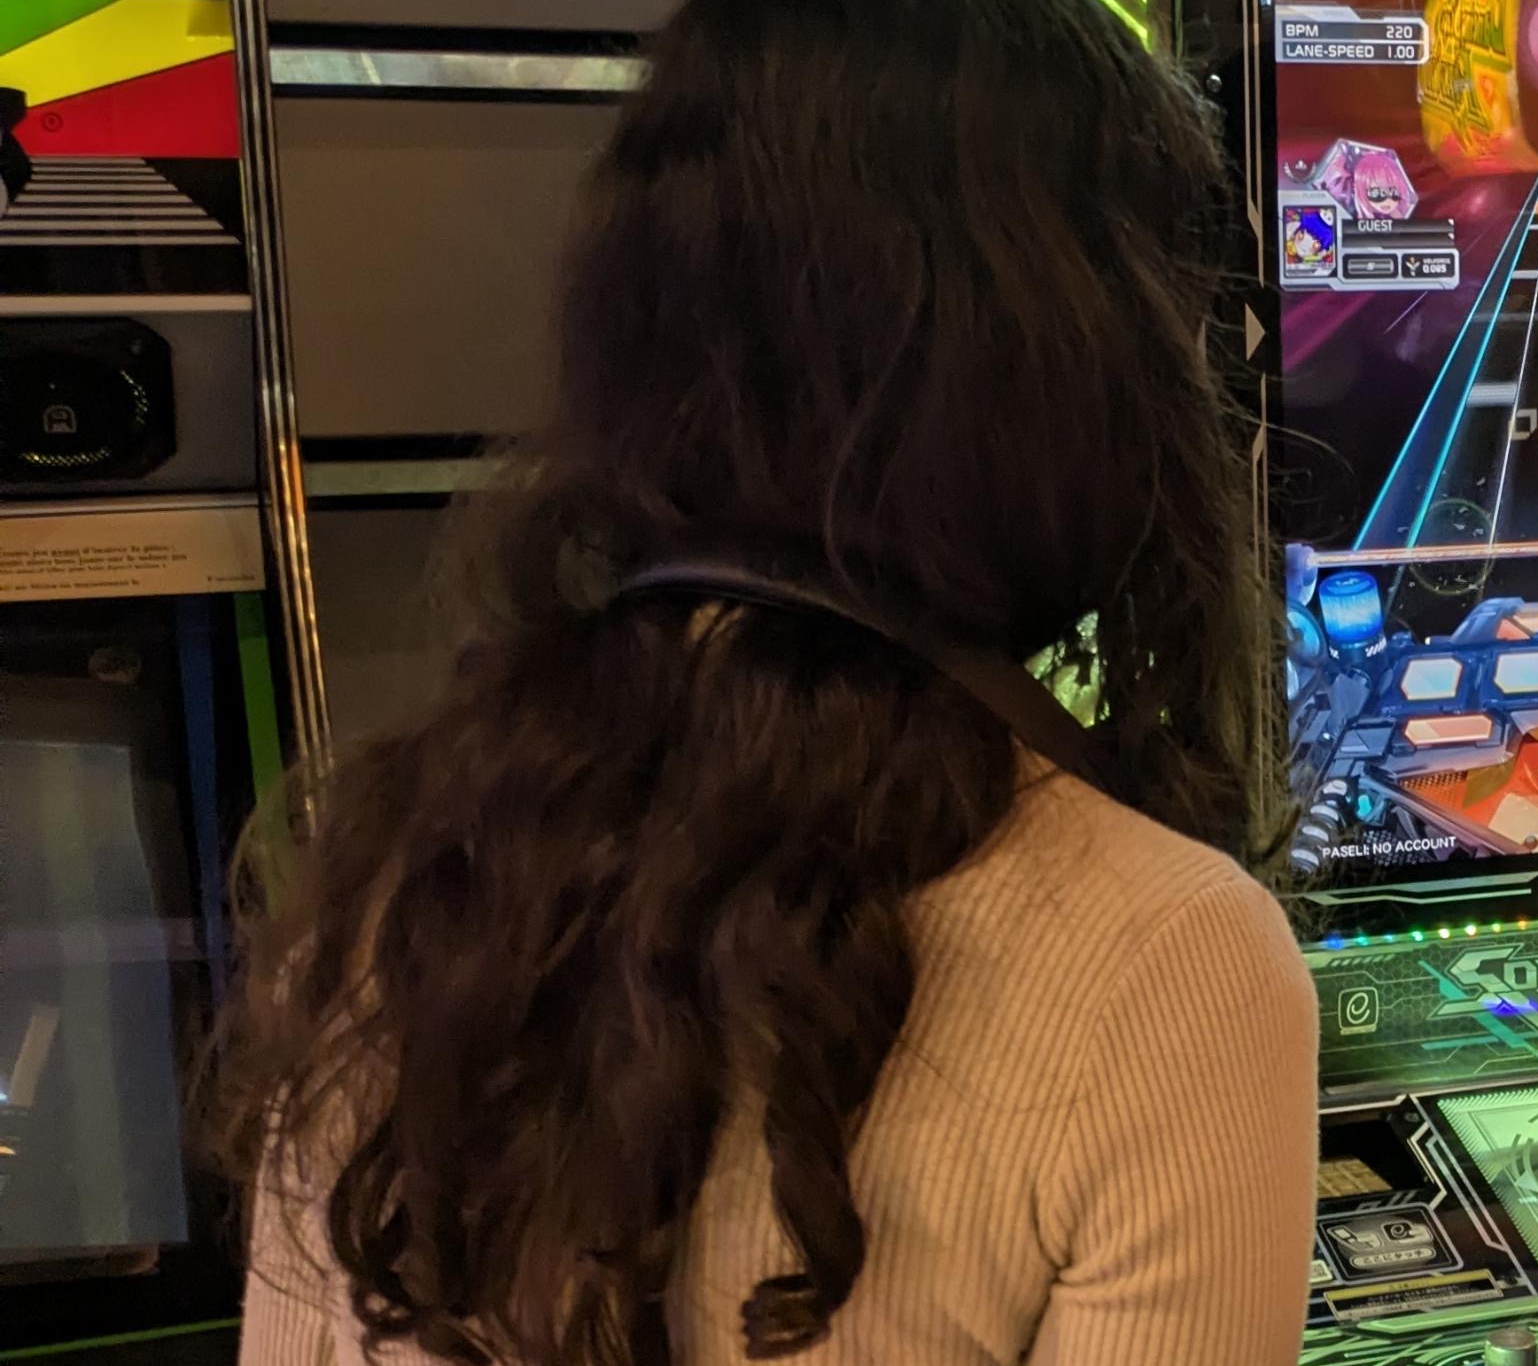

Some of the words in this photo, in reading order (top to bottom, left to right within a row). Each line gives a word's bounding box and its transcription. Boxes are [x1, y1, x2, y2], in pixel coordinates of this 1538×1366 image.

[1285, 24, 1319, 38] BPM
[1386, 25, 1413, 39] 220
[1285, 44, 1375, 59] LANE-SPEED
[1387, 45, 1415, 59] 1.00
[1357, 219, 1394, 233] GUEST
[1322, 845, 1371, 858] PASELI:
[1372, 841, 1393, 855] NO
[1395, 836, 1457, 852] ACCOUNT
